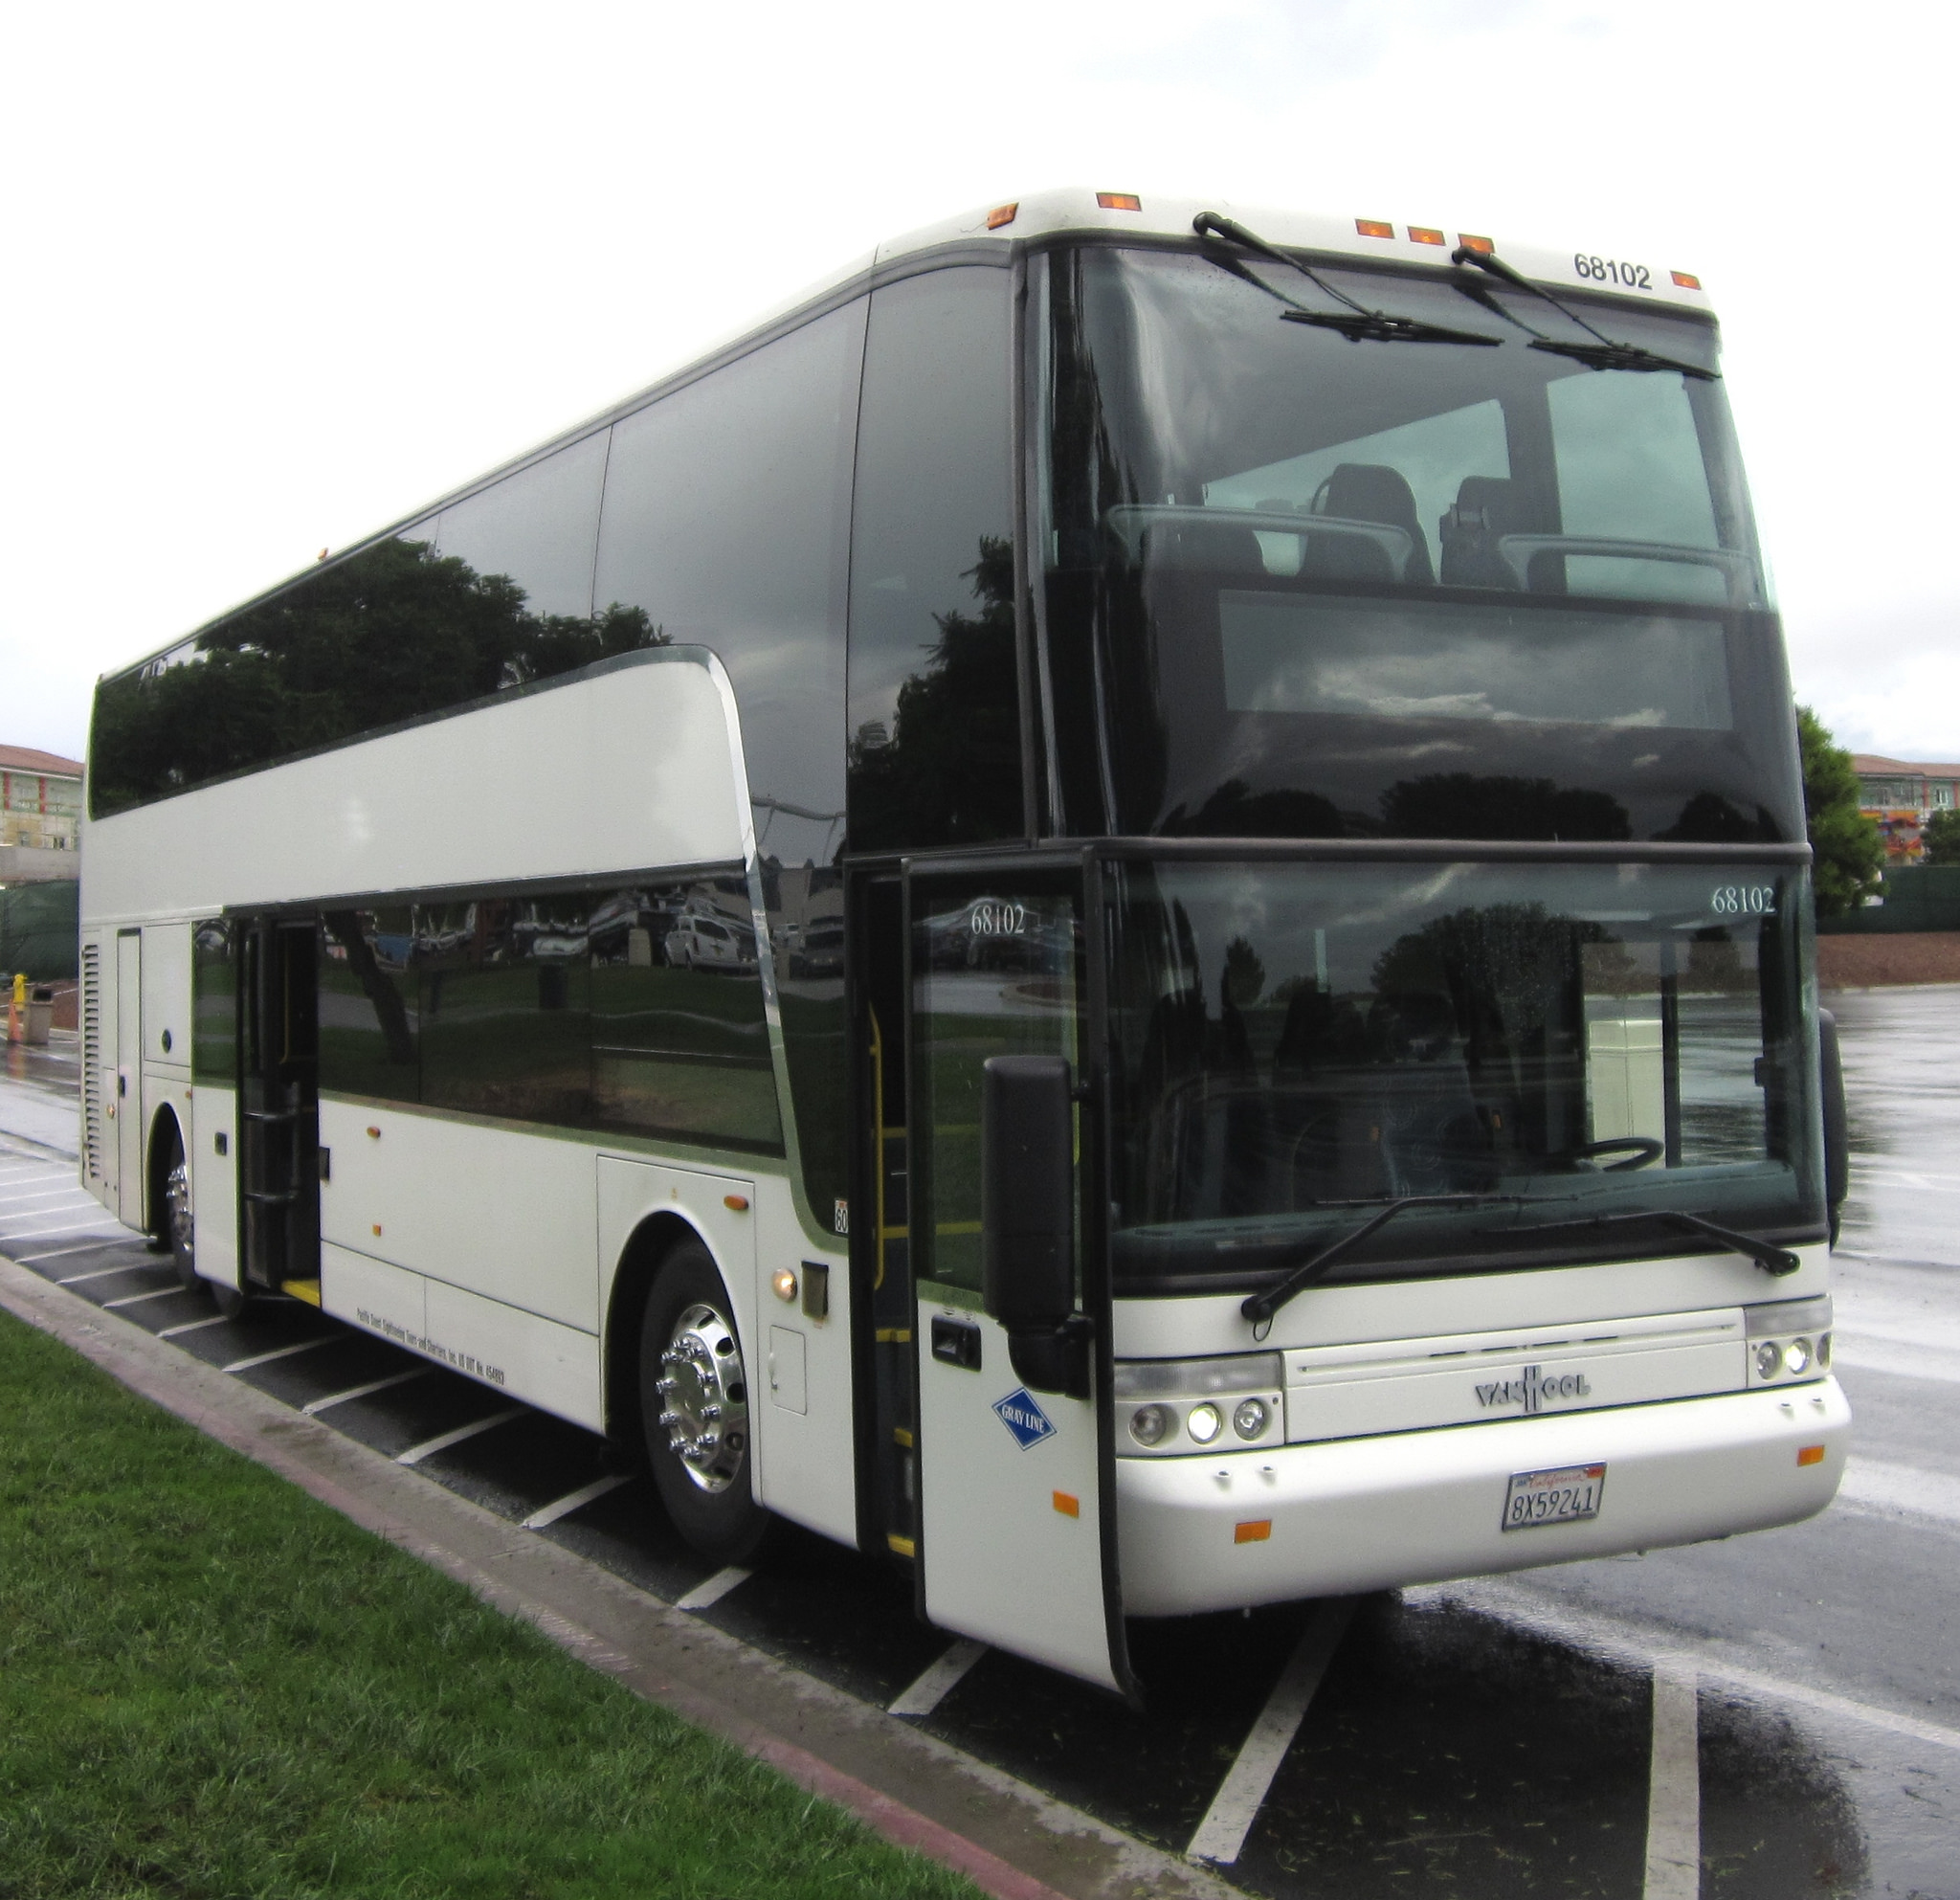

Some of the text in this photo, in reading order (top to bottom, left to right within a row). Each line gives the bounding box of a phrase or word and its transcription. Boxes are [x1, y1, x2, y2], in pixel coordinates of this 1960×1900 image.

[1574, 253, 1653, 290] 68102
[1712, 886, 1776, 913] 68102
[971, 905, 1025, 934] 68102
[836, 1208, 847, 1232] 60
[1001, 1404, 1045, 1434] GRAY LINE
[1512, 1486, 1593, 1522] 8X59241
